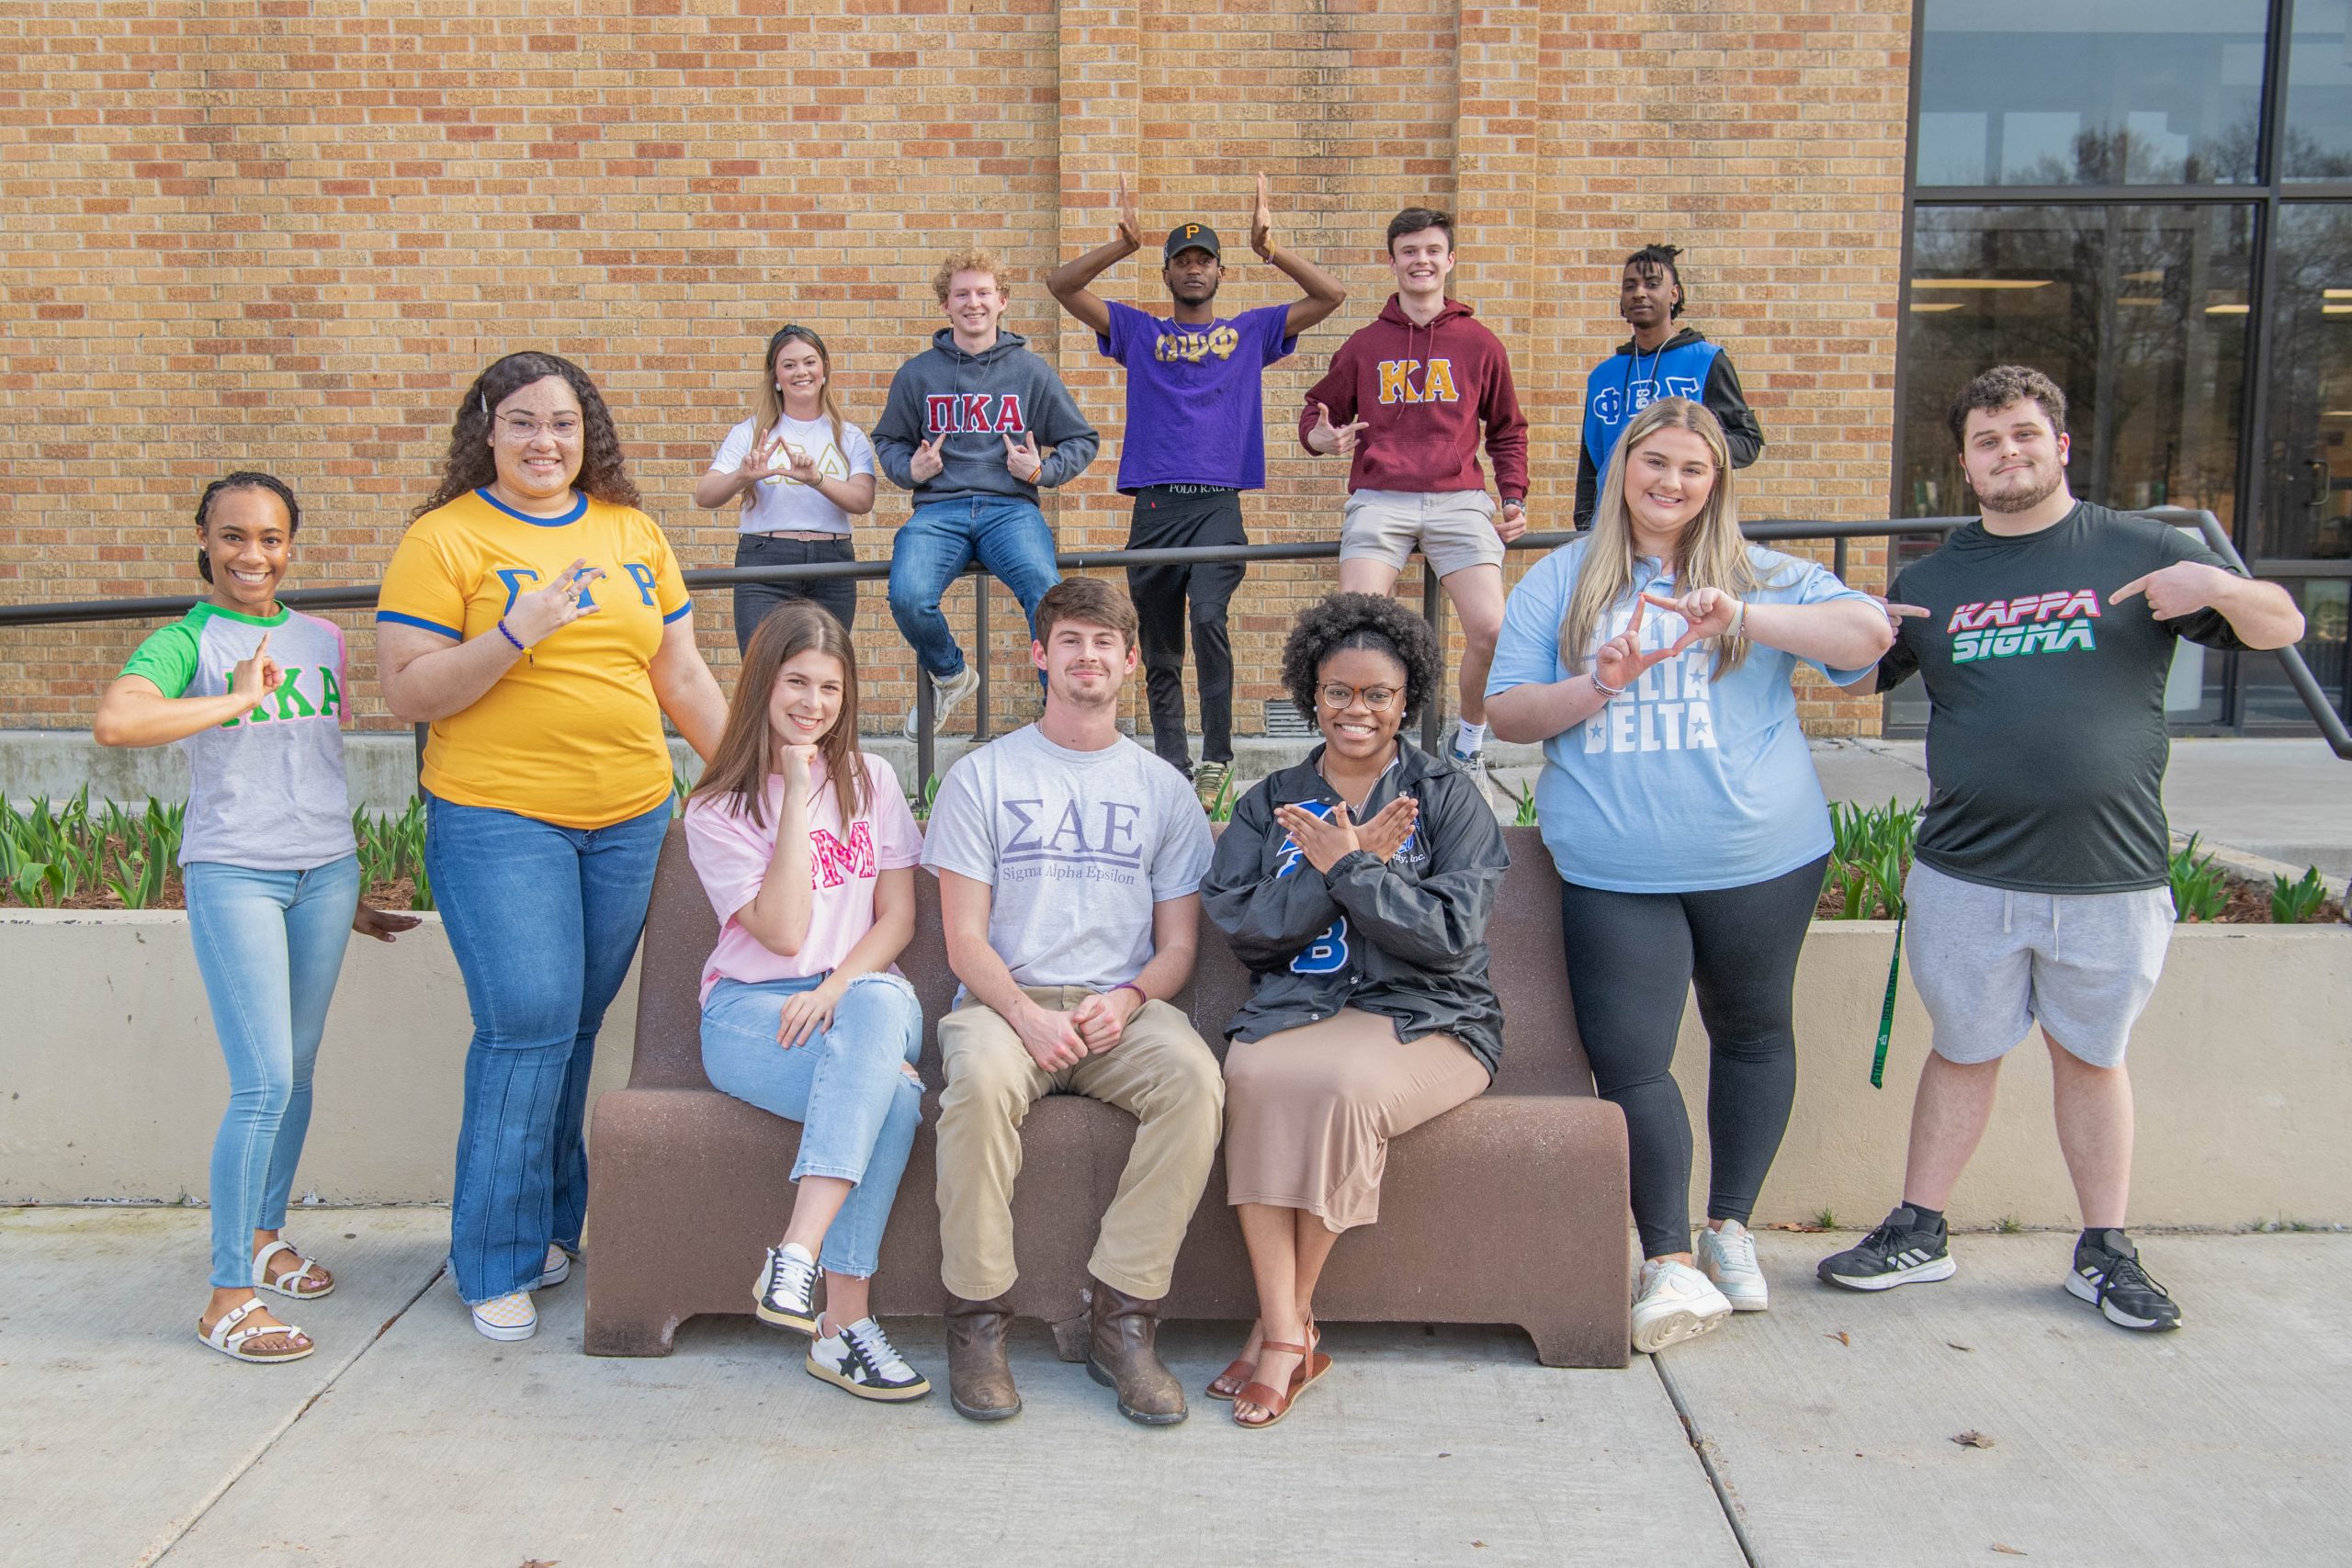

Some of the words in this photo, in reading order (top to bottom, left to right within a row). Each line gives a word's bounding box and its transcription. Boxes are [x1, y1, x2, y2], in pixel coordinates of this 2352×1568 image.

[1185, 225, 1200, 240] P
[1169, 483, 1197, 494] POLO
[1947, 589, 2101, 634] KAPPA
[1952, 618, 2097, 665] SIGMA
[1584, 701, 1718, 754] DELTA
[1002, 865, 1042, 883] Sigma
[1046, 863, 1082, 882] Alpha
[1085, 865, 1136, 885] Epsilon
[1882, 996, 1894, 1021] DELTA
[1871, 1054, 1884, 1080] STATE
